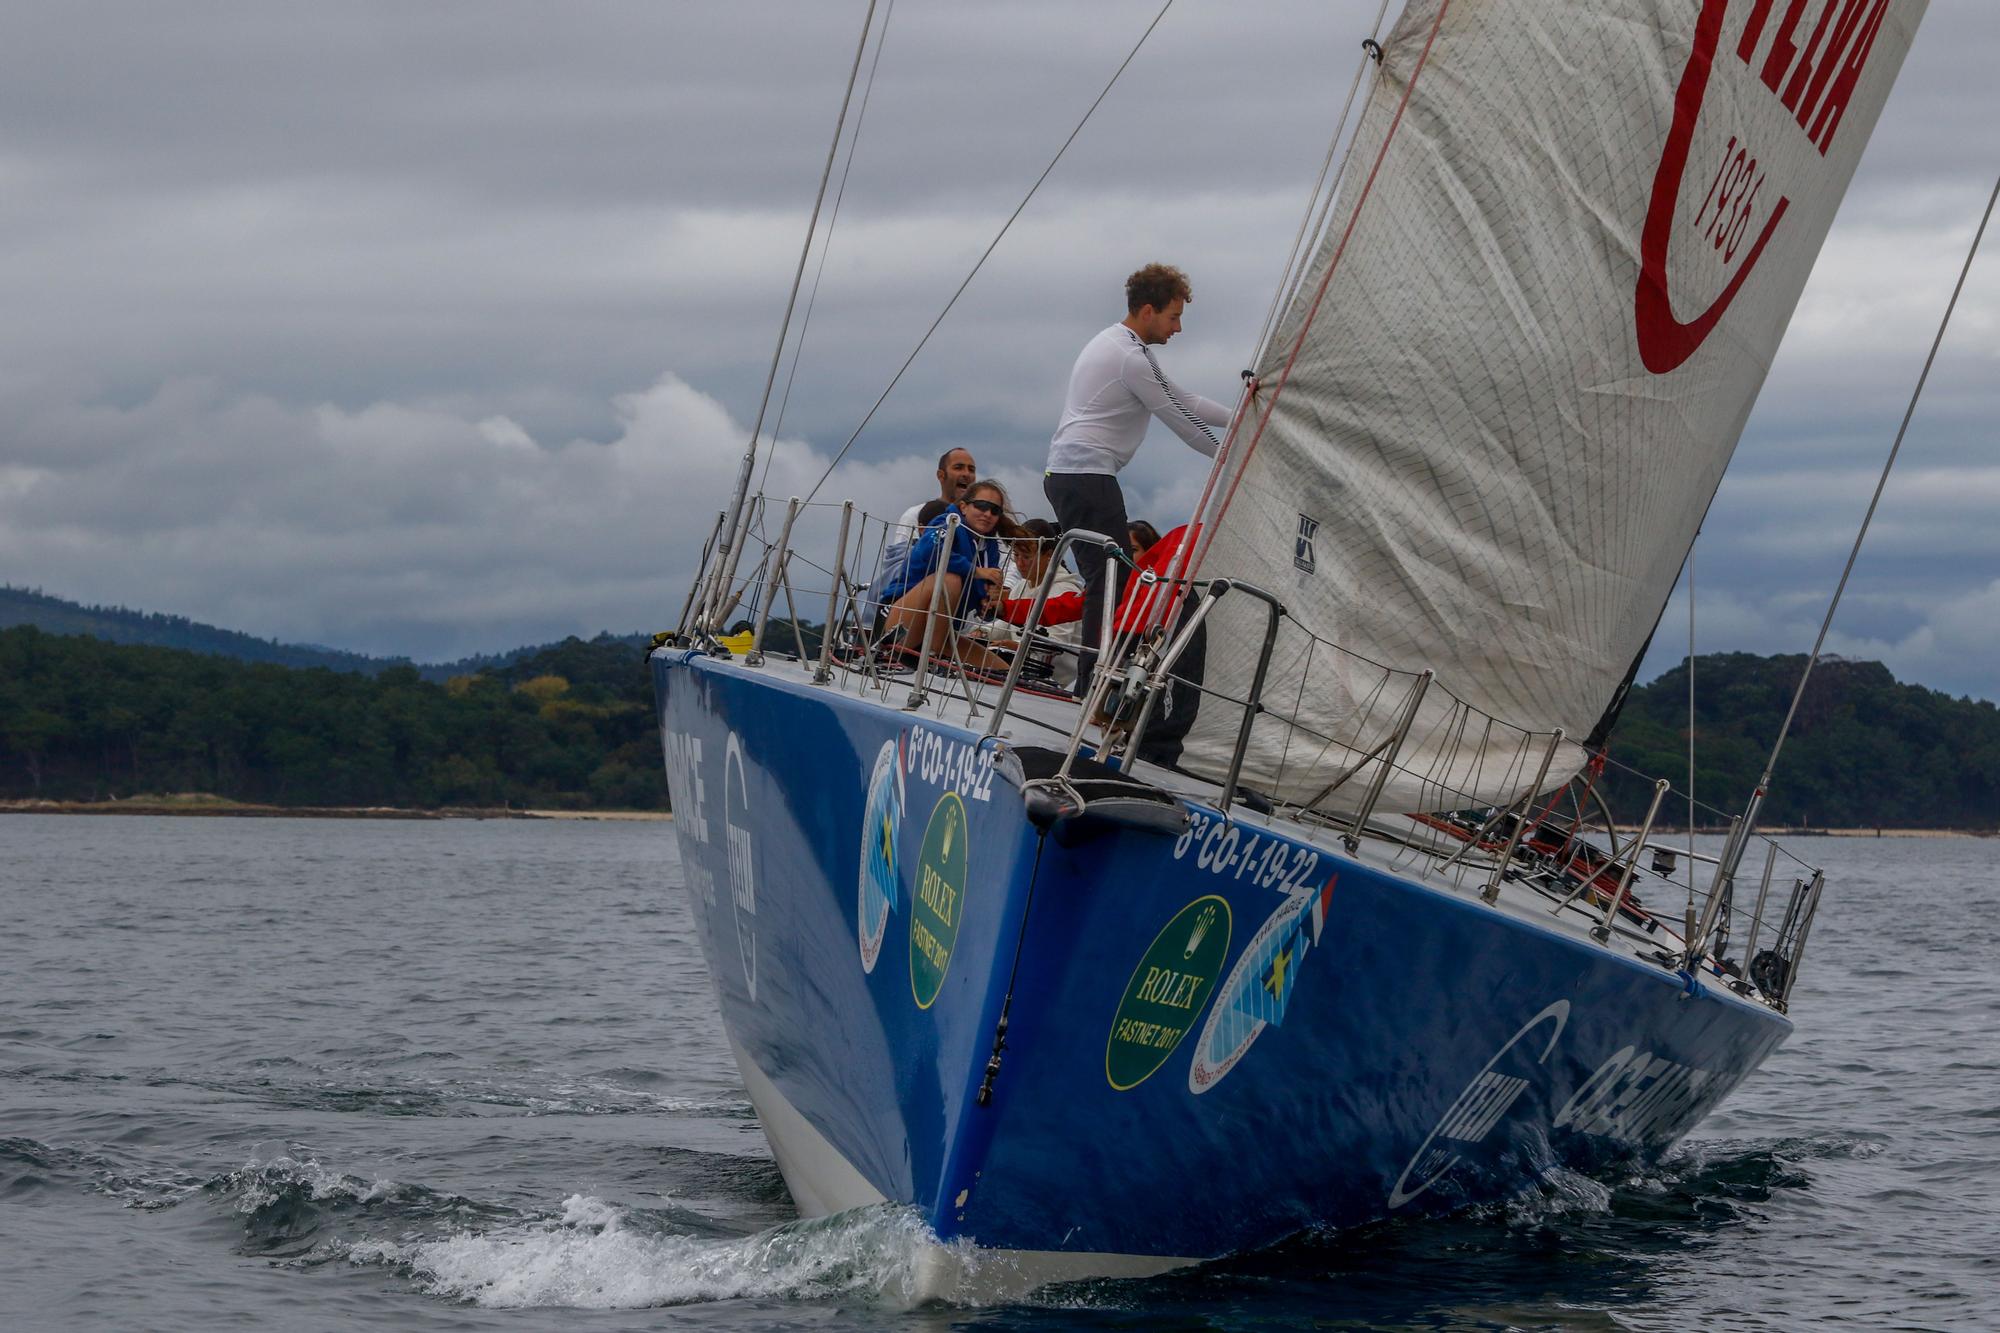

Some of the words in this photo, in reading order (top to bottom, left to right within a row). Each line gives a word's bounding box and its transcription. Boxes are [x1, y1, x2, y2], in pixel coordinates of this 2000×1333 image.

[1694, 135, 1765, 265] 1936
[921, 864, 956, 928] ROLEX
[913, 918, 936, 961] FASTNET
[933, 943, 948, 973] 2017
[1136, 966, 1204, 1009] ROLEX
[1115, 1018, 1161, 1046] FASTNET
[1154, 1027, 1182, 1049] 2017
